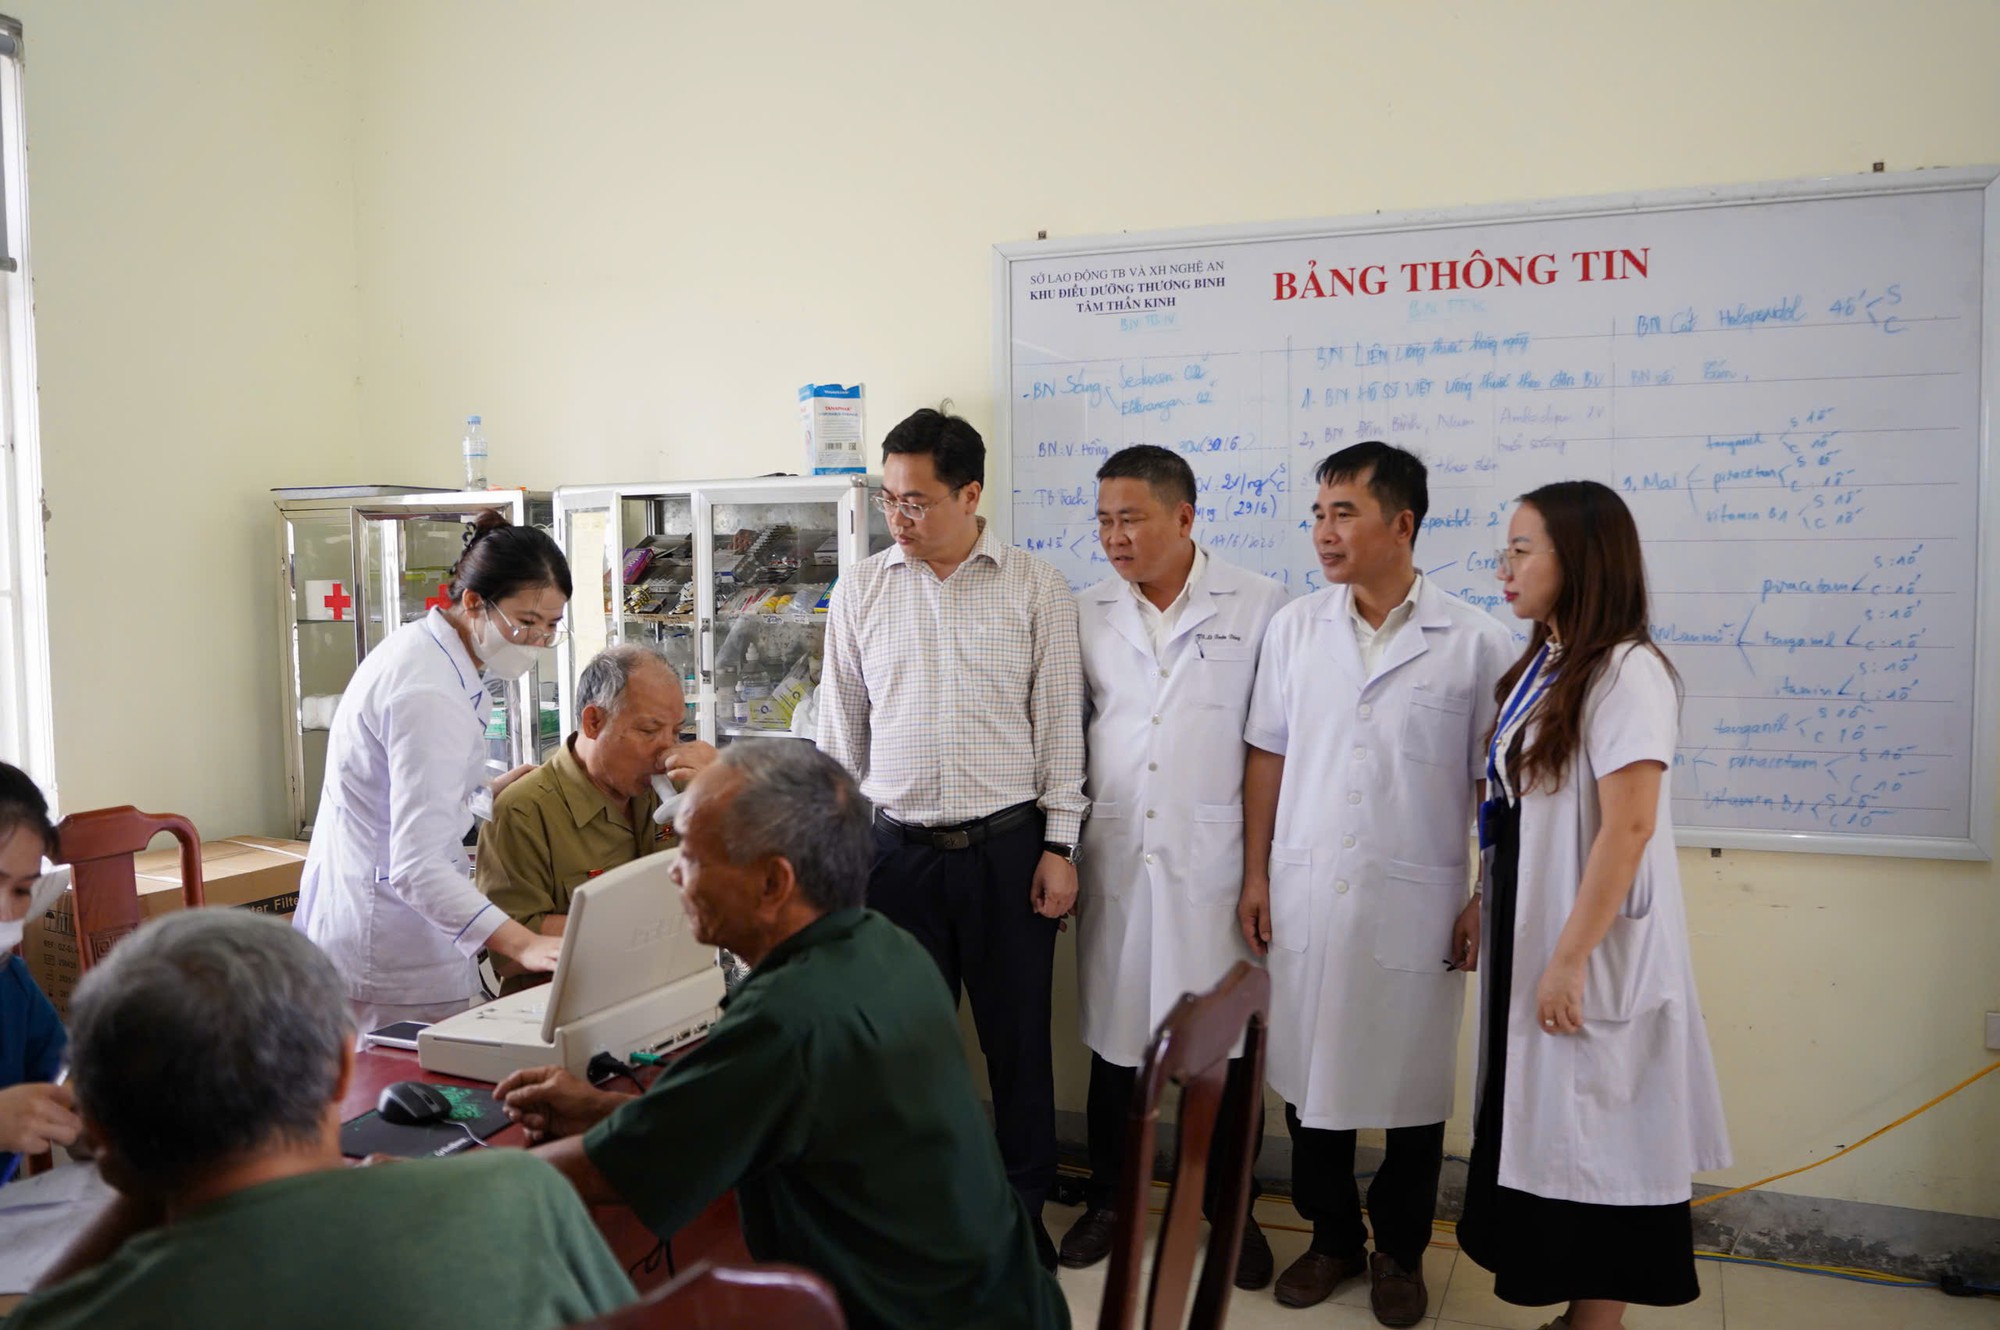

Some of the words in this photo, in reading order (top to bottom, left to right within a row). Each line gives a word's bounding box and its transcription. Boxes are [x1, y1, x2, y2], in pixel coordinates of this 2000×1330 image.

[1030, 272, 1045, 285] SỞ
[1047, 272, 1071, 283] LAO
[1074, 269, 1108, 284] ĐỘNG
[1111, 268, 1126, 279] TB
[1129, 263, 1146, 278] VÀ
[1149, 265, 1167, 276] XH
[1169, 260, 1203, 275] NGHỆ
[1206, 261, 1225, 272] AN
[1272, 259, 1388, 301] BẢNG
[1401, 249, 1559, 293] THÔNG
[1571, 247, 1651, 282] TIN
[1030, 290, 1055, 301] KHU
[1058, 283, 1087, 299] ĐIỀU
[1090, 280, 1134, 297] DƯỠNG
[1137, 279, 1191, 294] THƯƠNG
[1194, 276, 1226, 289] BINH
[1077, 299, 1103, 313] TÂM
[1144, 297, 1176, 309] KINH
[274, 896, 299, 912] Filte
